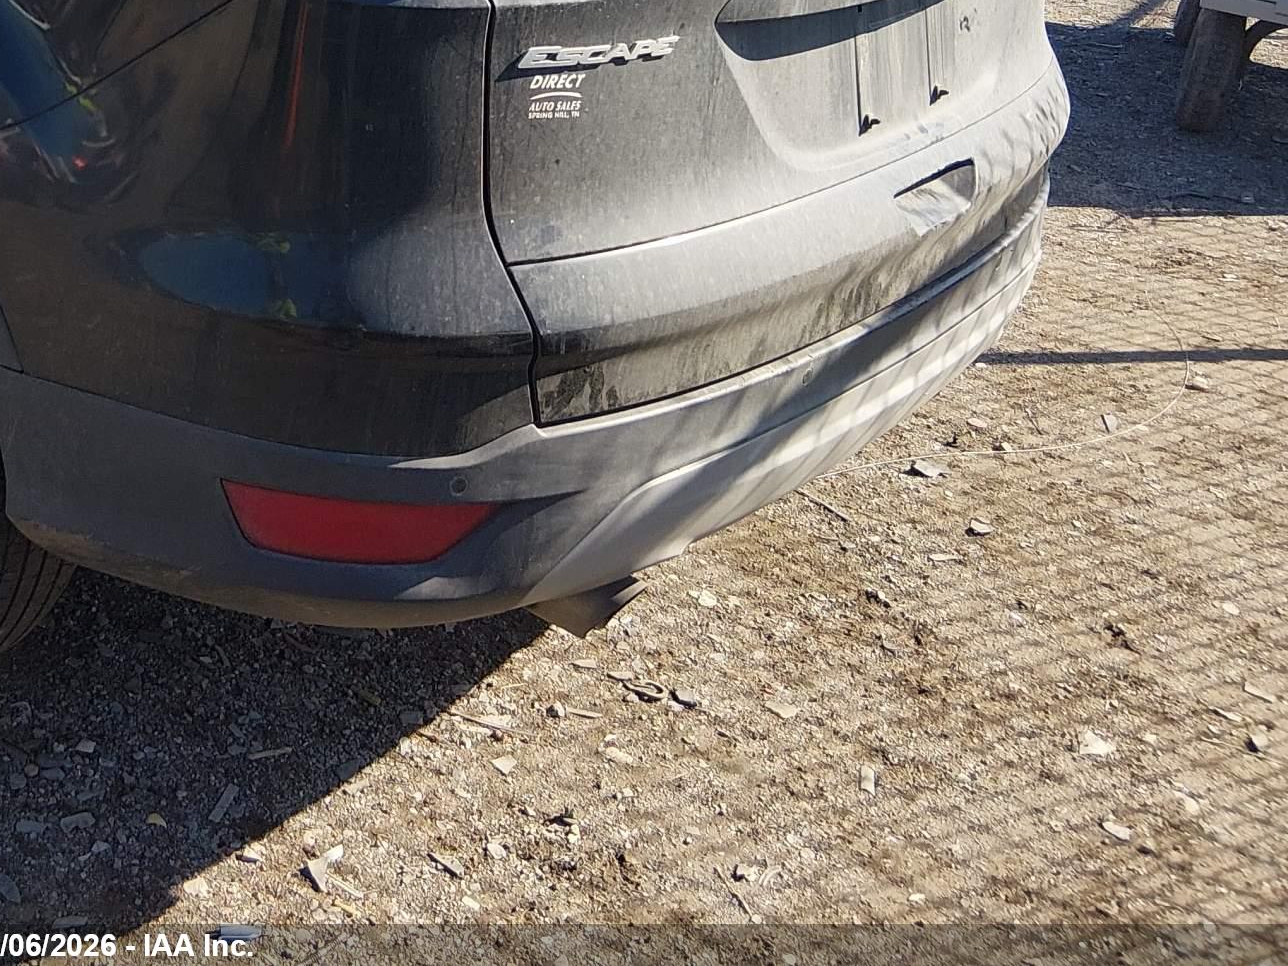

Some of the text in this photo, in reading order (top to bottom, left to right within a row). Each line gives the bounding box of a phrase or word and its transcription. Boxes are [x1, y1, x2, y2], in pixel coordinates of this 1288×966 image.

[518, 35, 681, 69] ESCAPE
[529, 73, 586, 89] DIRECT
[528, 100, 582, 112] AUTO SALES
[528, 111, 553, 119] SPRING
